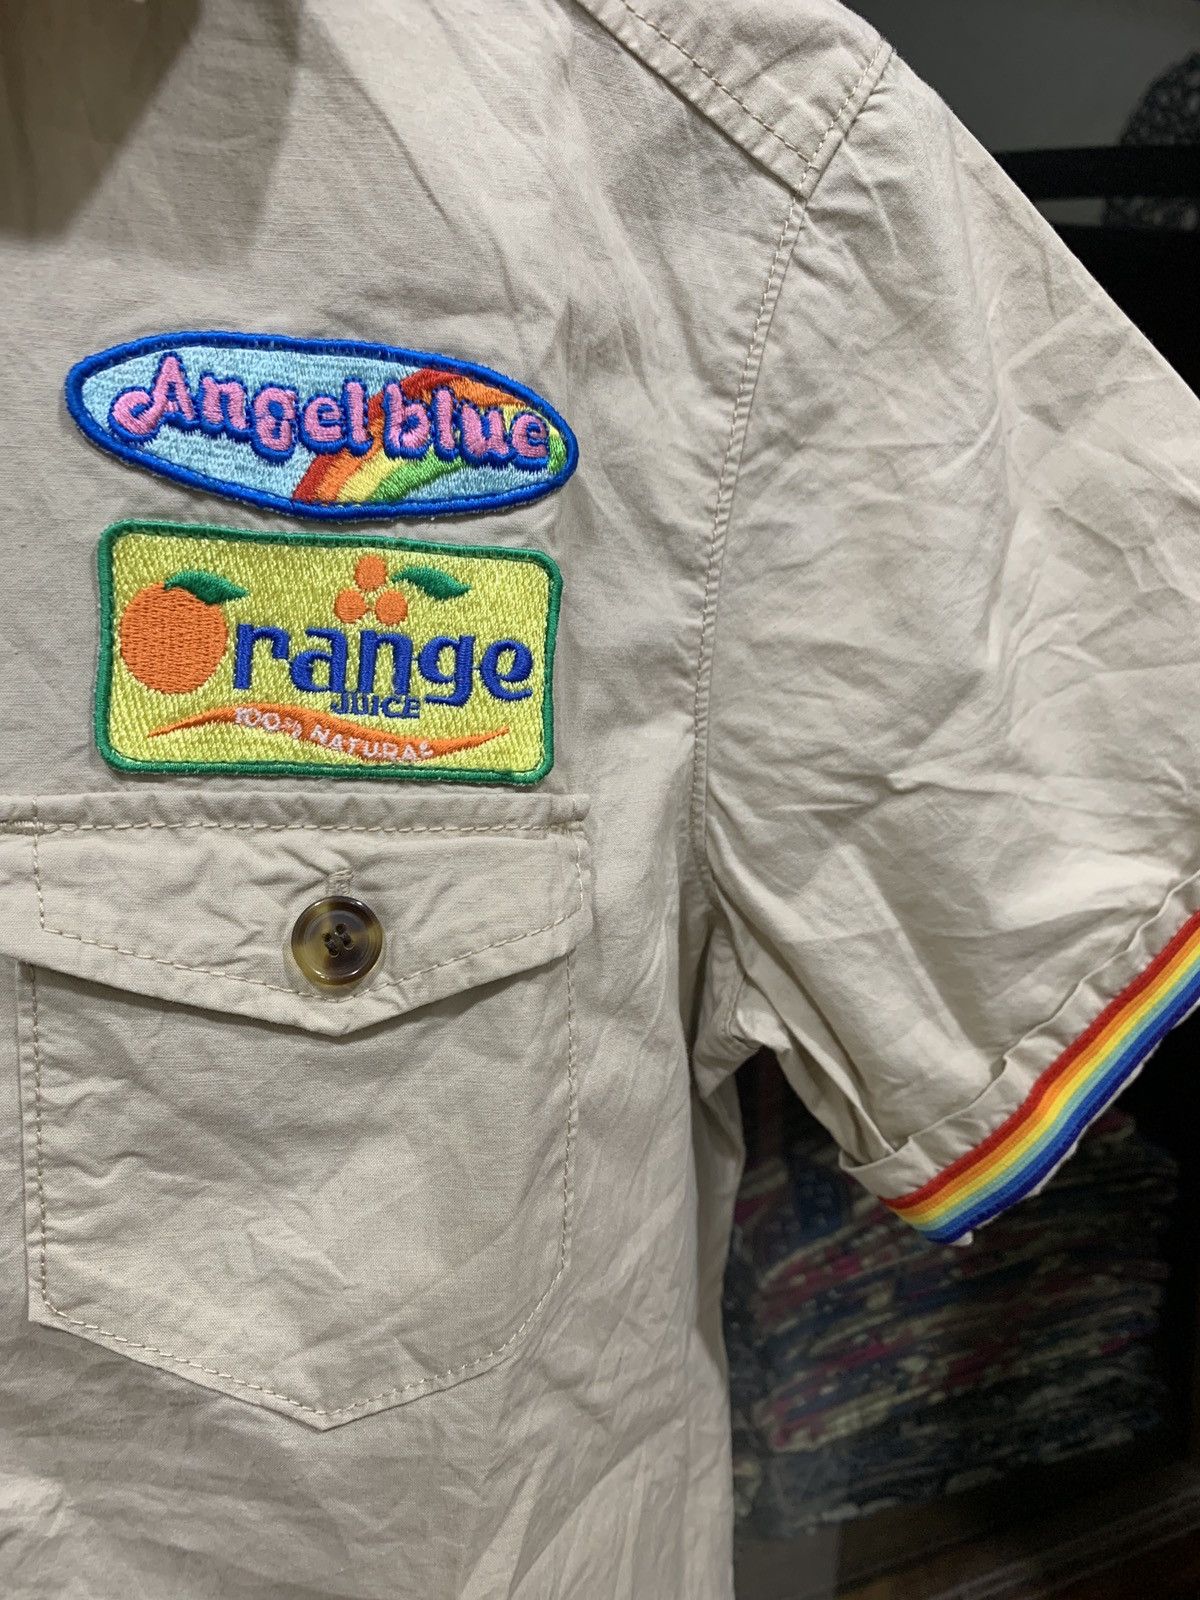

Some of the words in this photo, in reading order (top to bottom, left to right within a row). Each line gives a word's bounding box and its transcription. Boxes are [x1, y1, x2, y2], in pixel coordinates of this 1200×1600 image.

[109, 352, 370, 463] Angel
[382, 380, 554, 469] blue
[331, 692, 421, 719] JUICE
[234, 706, 302, 741] 100%
